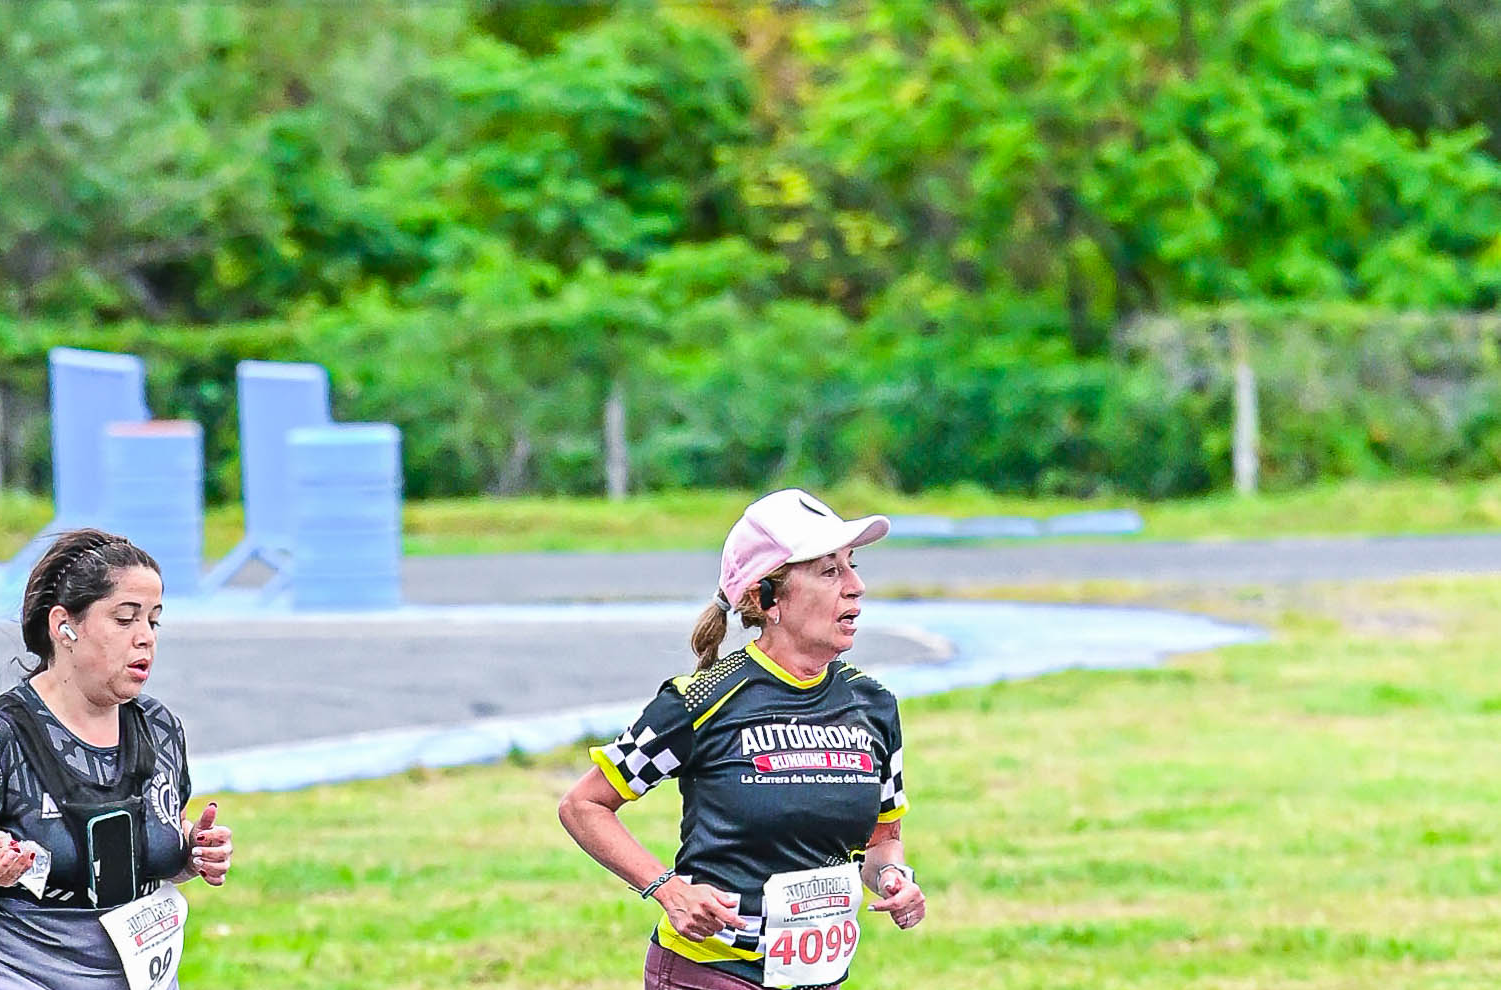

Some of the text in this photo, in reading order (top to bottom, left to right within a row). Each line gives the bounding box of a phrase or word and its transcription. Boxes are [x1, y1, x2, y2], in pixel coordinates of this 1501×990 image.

[741, 717, 873, 756] AUTÓDROMO
[768, 752, 863, 771] RUNNING RACE
[740, 774, 754, 784] La
[754, 774, 790, 784] Carrera
[802, 774, 815, 784] los
[769, 920, 857, 965] 4099
